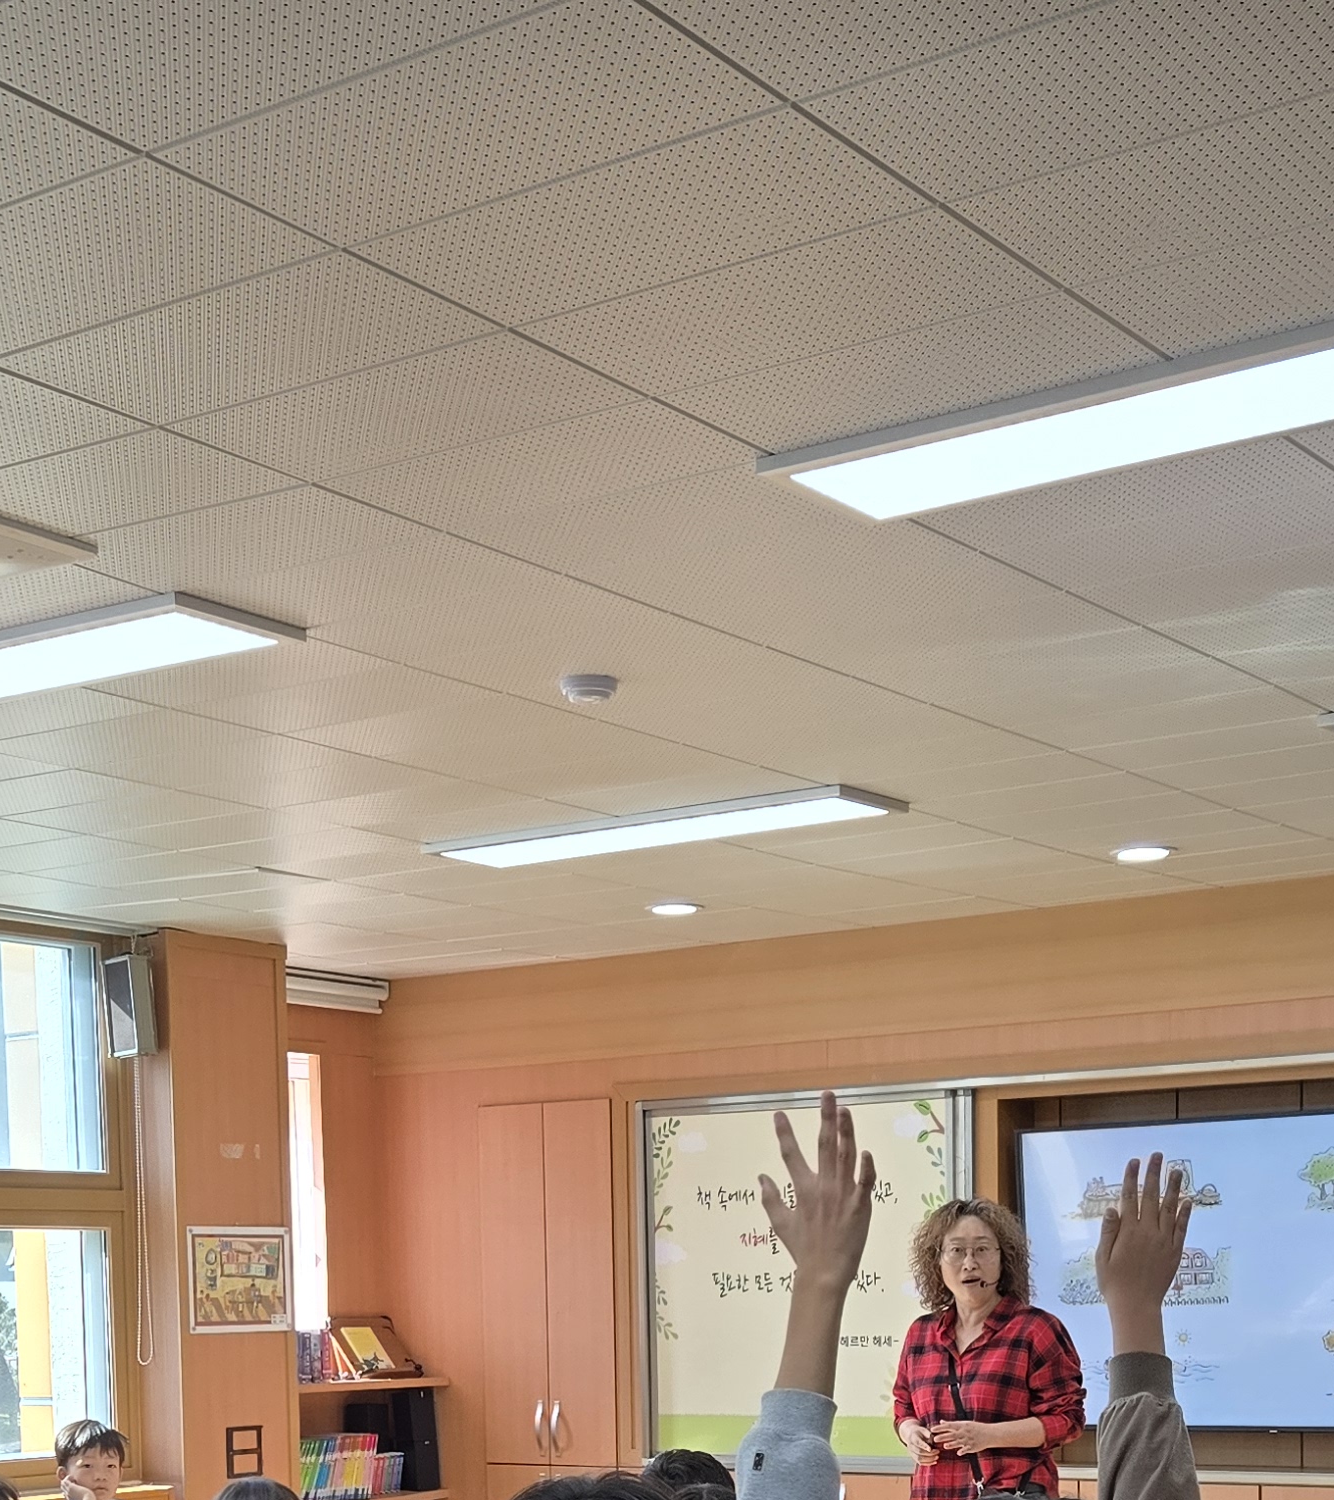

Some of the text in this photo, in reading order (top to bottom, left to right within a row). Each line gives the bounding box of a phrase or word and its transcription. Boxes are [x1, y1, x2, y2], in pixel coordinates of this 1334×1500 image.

[697, 1186, 711, 1210] 책
[717, 1186, 755, 1211] 속에서
[871, 1180, 898, 1204] 있고,
[739, 1227, 780, 1255] 지혜를
[712, 1269, 885, 1298] 필요한 모든 것 있다.
[840, 1335, 870, 1348] 헤르만
